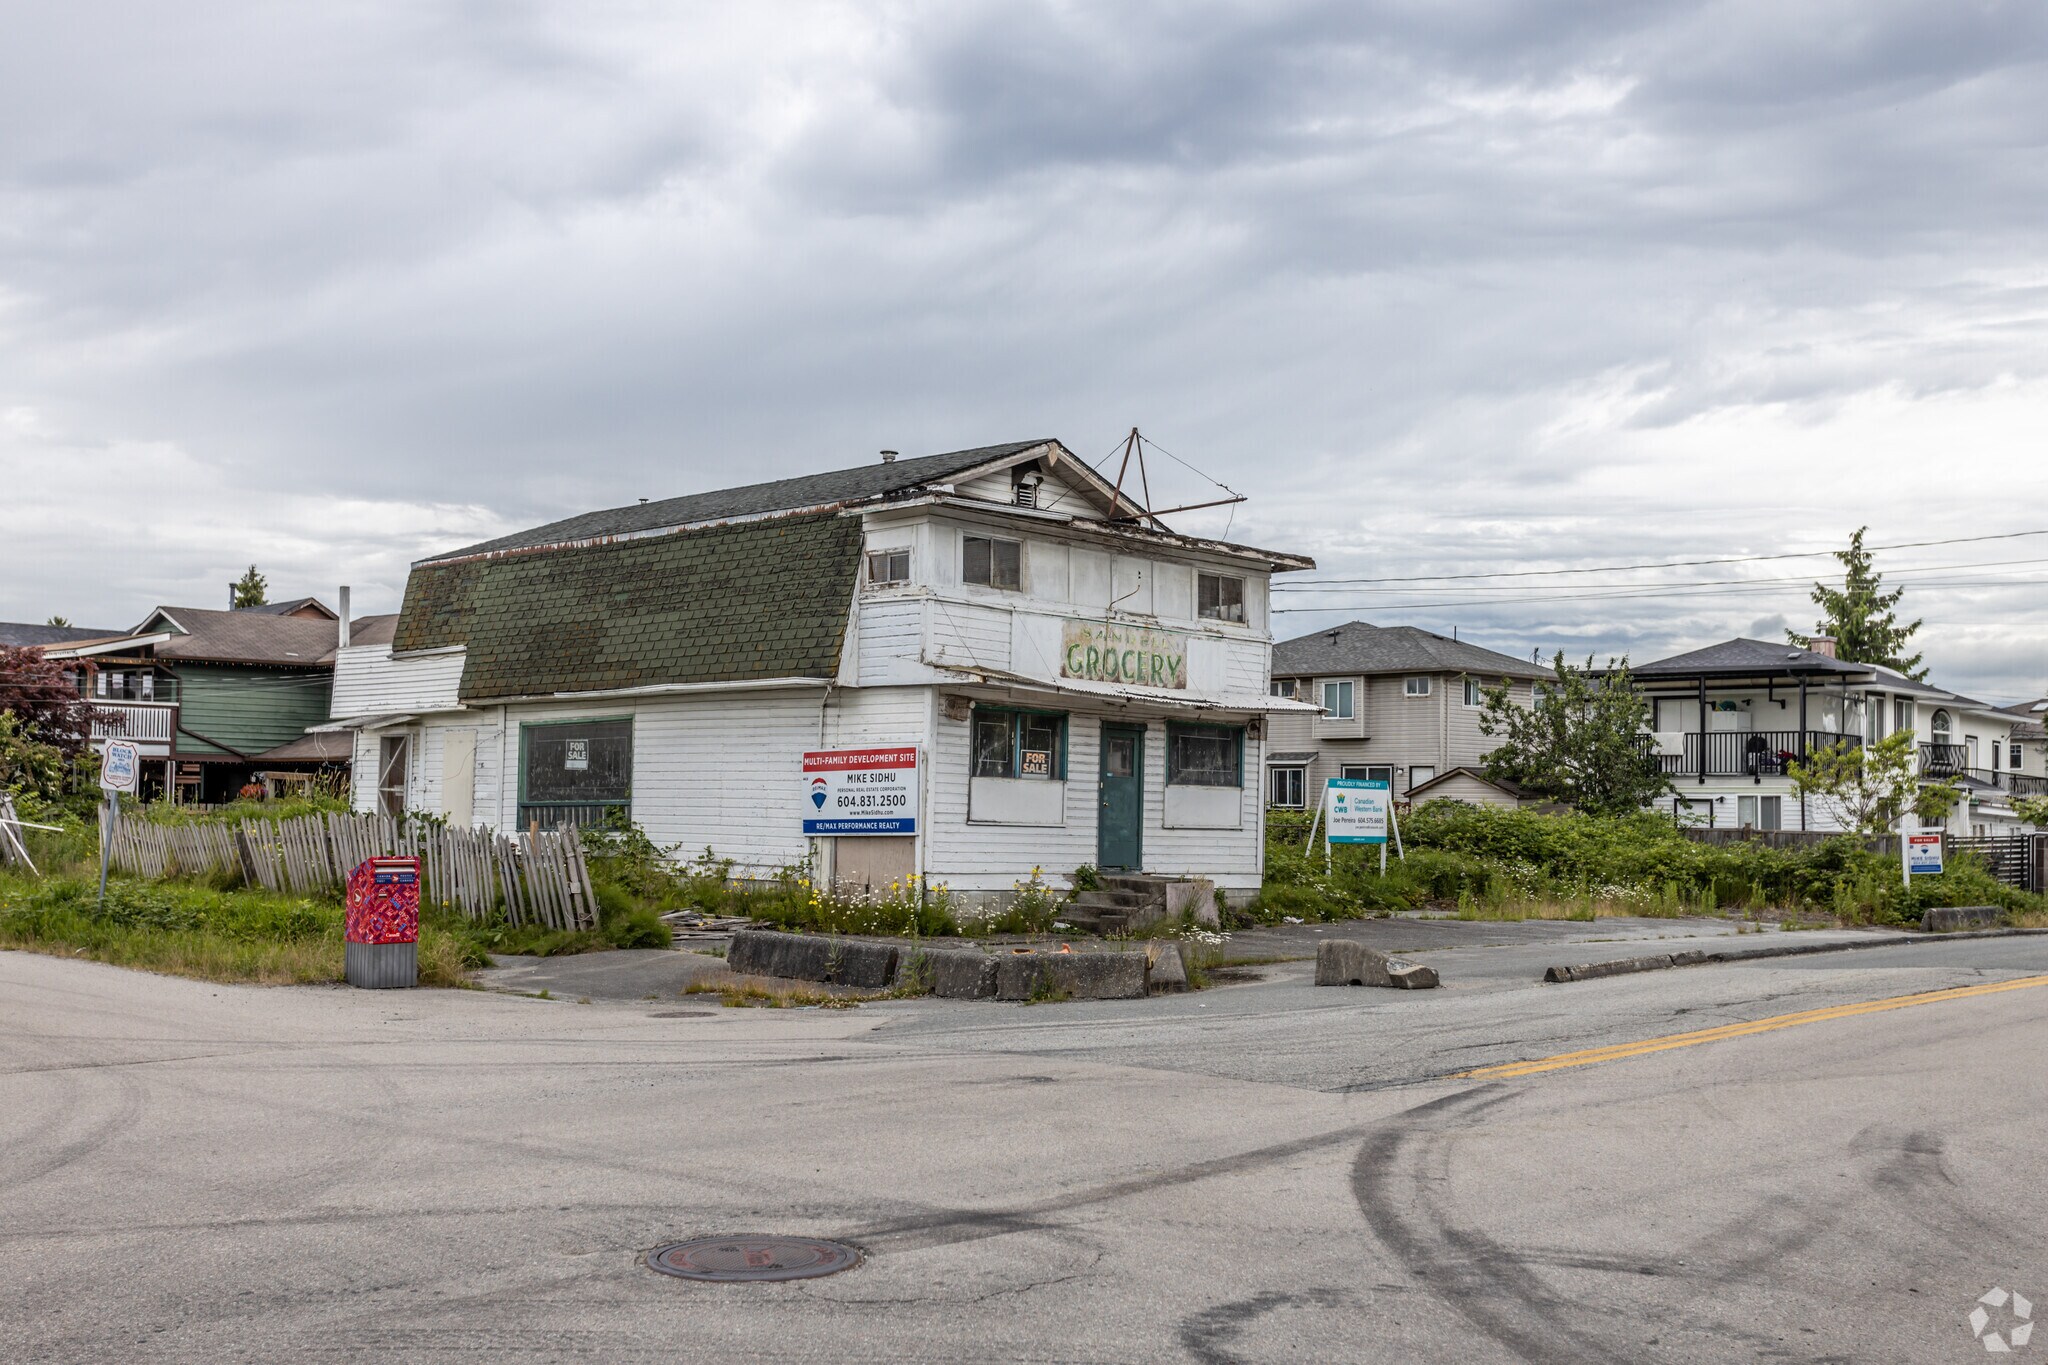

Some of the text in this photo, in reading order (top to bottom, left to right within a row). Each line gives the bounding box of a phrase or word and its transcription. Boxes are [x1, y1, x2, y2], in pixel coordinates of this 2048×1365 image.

[1066, 643, 1182, 684] GROCERY
[112, 747, 132, 755] BLOCK
[570, 742, 585, 750] FOR
[112, 752, 132, 760] WATCH
[567, 751, 586, 760] SALE
[804, 753, 915, 766] MULTI-FAMILY DEVELOPMENT SITE
[1026, 752, 1046, 764] FOR
[1022, 763, 1047, 773] SALE
[847, 773, 896, 783] MIKE SIDHU
[837, 795, 906, 808] 604.831.2500
[838, 822, 878, 830] PERFORMANCE
